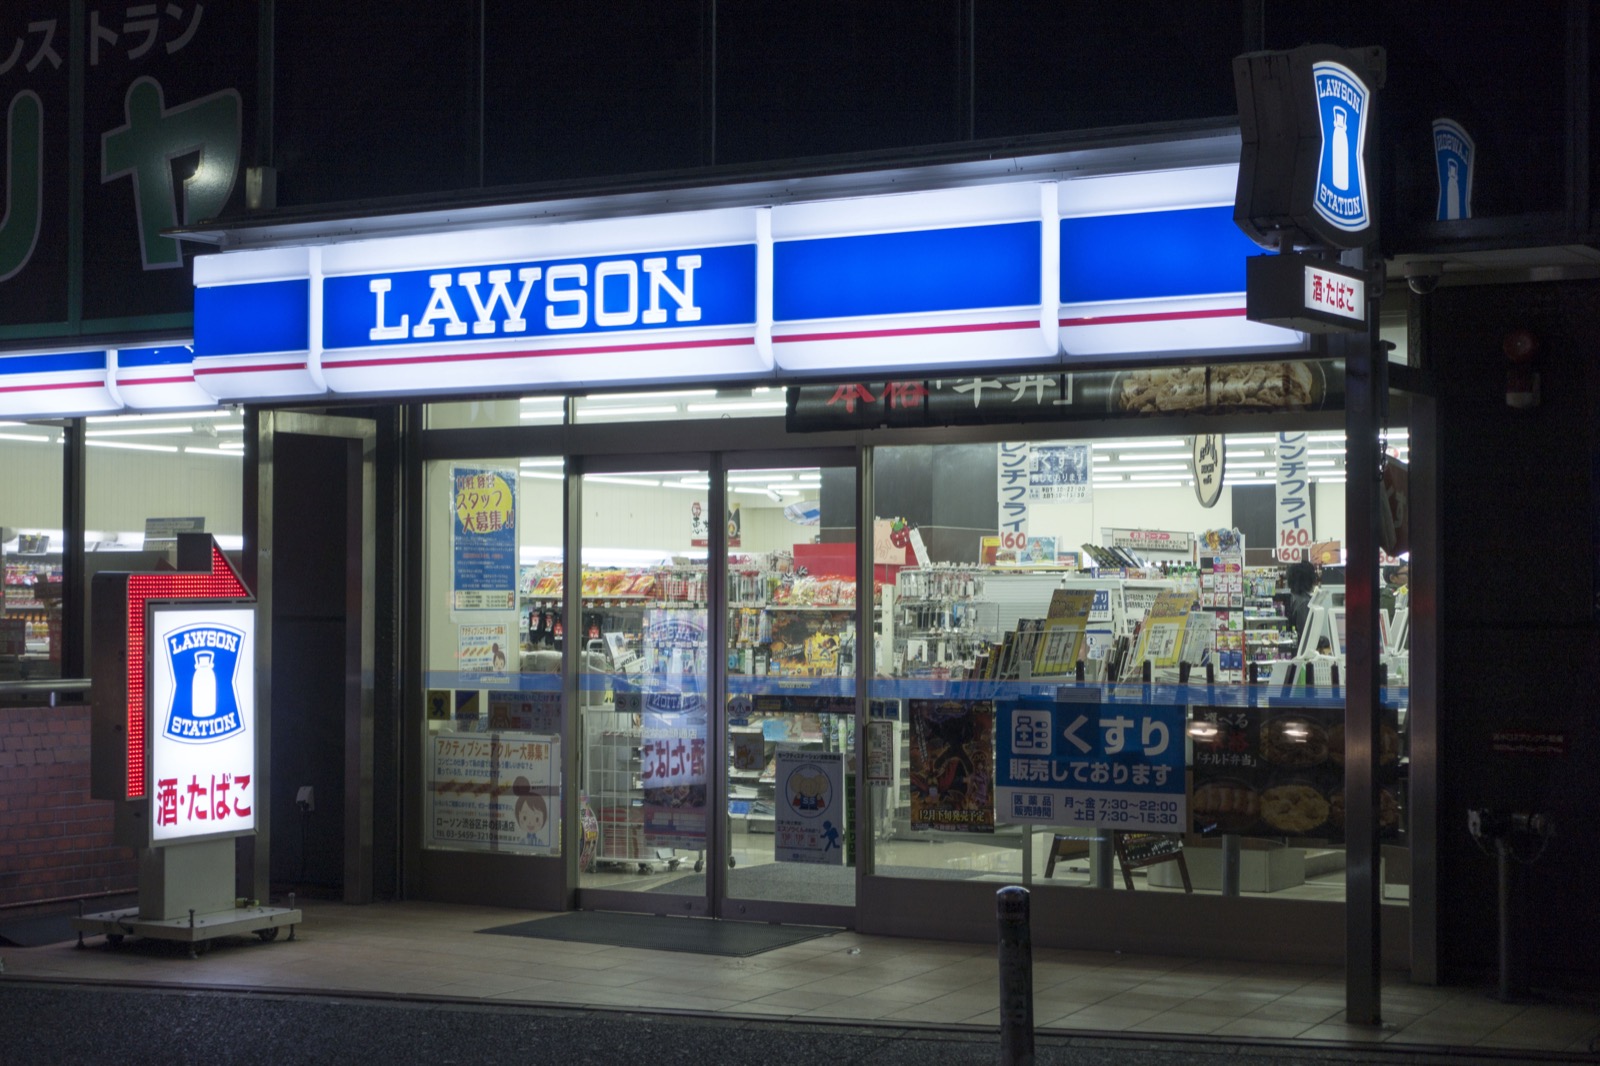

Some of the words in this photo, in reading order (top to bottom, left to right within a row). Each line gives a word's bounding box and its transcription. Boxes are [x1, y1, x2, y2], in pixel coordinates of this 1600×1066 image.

[1318, 79, 1360, 114] LAWSON
[1320, 182, 1360, 215] STATION
[369, 255, 702, 340] LAWSON
[1312, 274, 1354, 312] 酒・たばこ
[456, 490, 502, 511] スタッフ
[171, 630, 238, 655] LAWSON
[171, 712, 236, 737] STATION
[1063, 714, 1170, 756] くすり
[1009, 758, 1172, 786] 販売しております
[156, 772, 251, 827] 酒・たばこ
[1014, 805, 1051, 818] 販売時間
[919, 809, 985, 822] 12月下旬発売予定
[1074, 809, 1095, 821] 土日
